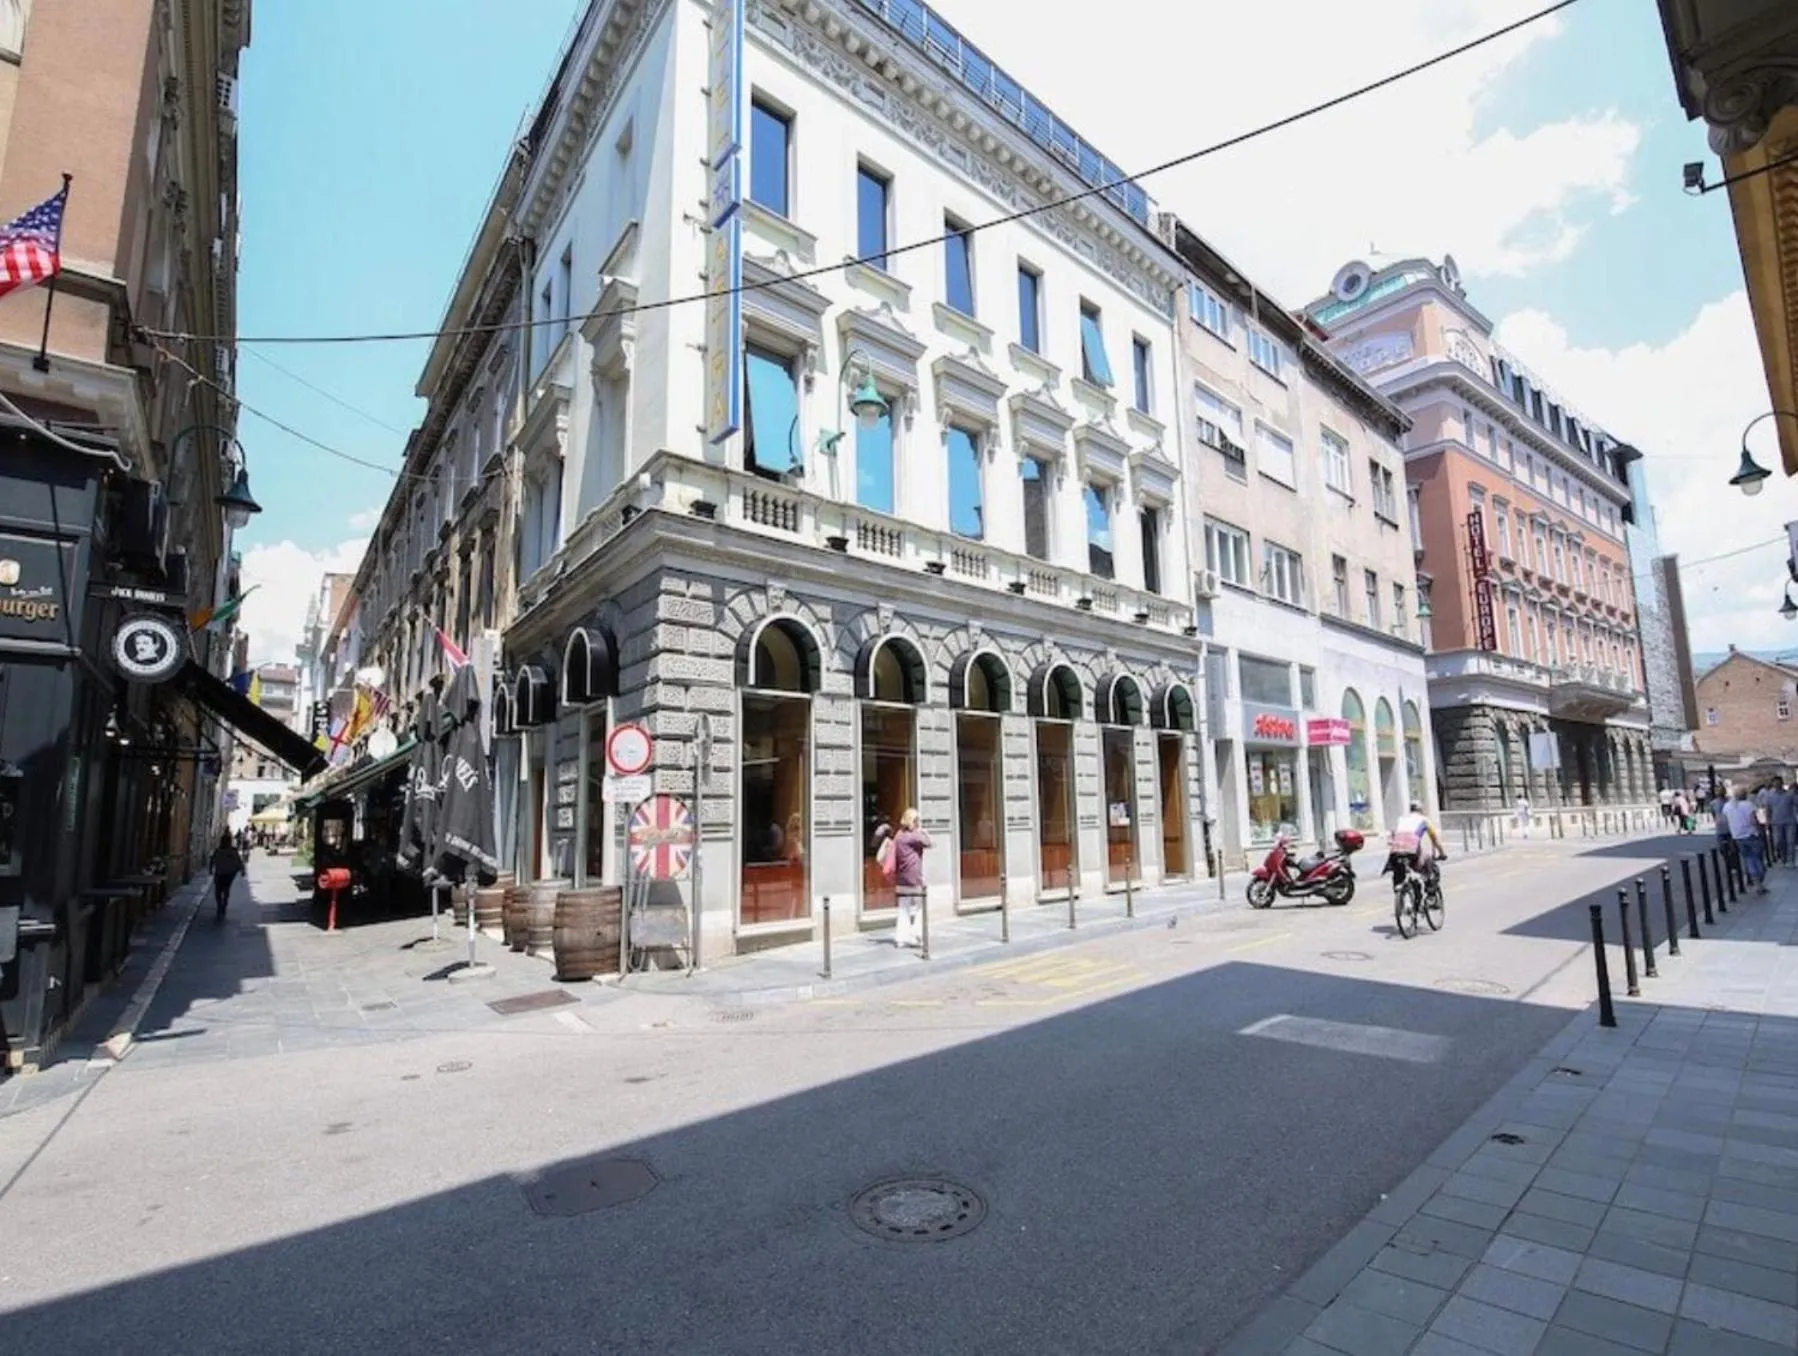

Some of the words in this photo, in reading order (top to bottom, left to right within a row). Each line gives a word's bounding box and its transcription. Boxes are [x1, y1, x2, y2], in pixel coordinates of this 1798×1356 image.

[1469, 513, 1485, 568] HOTEL
[0, 600, 59, 620] urger
[1477, 582, 1494, 650] EUROPE
